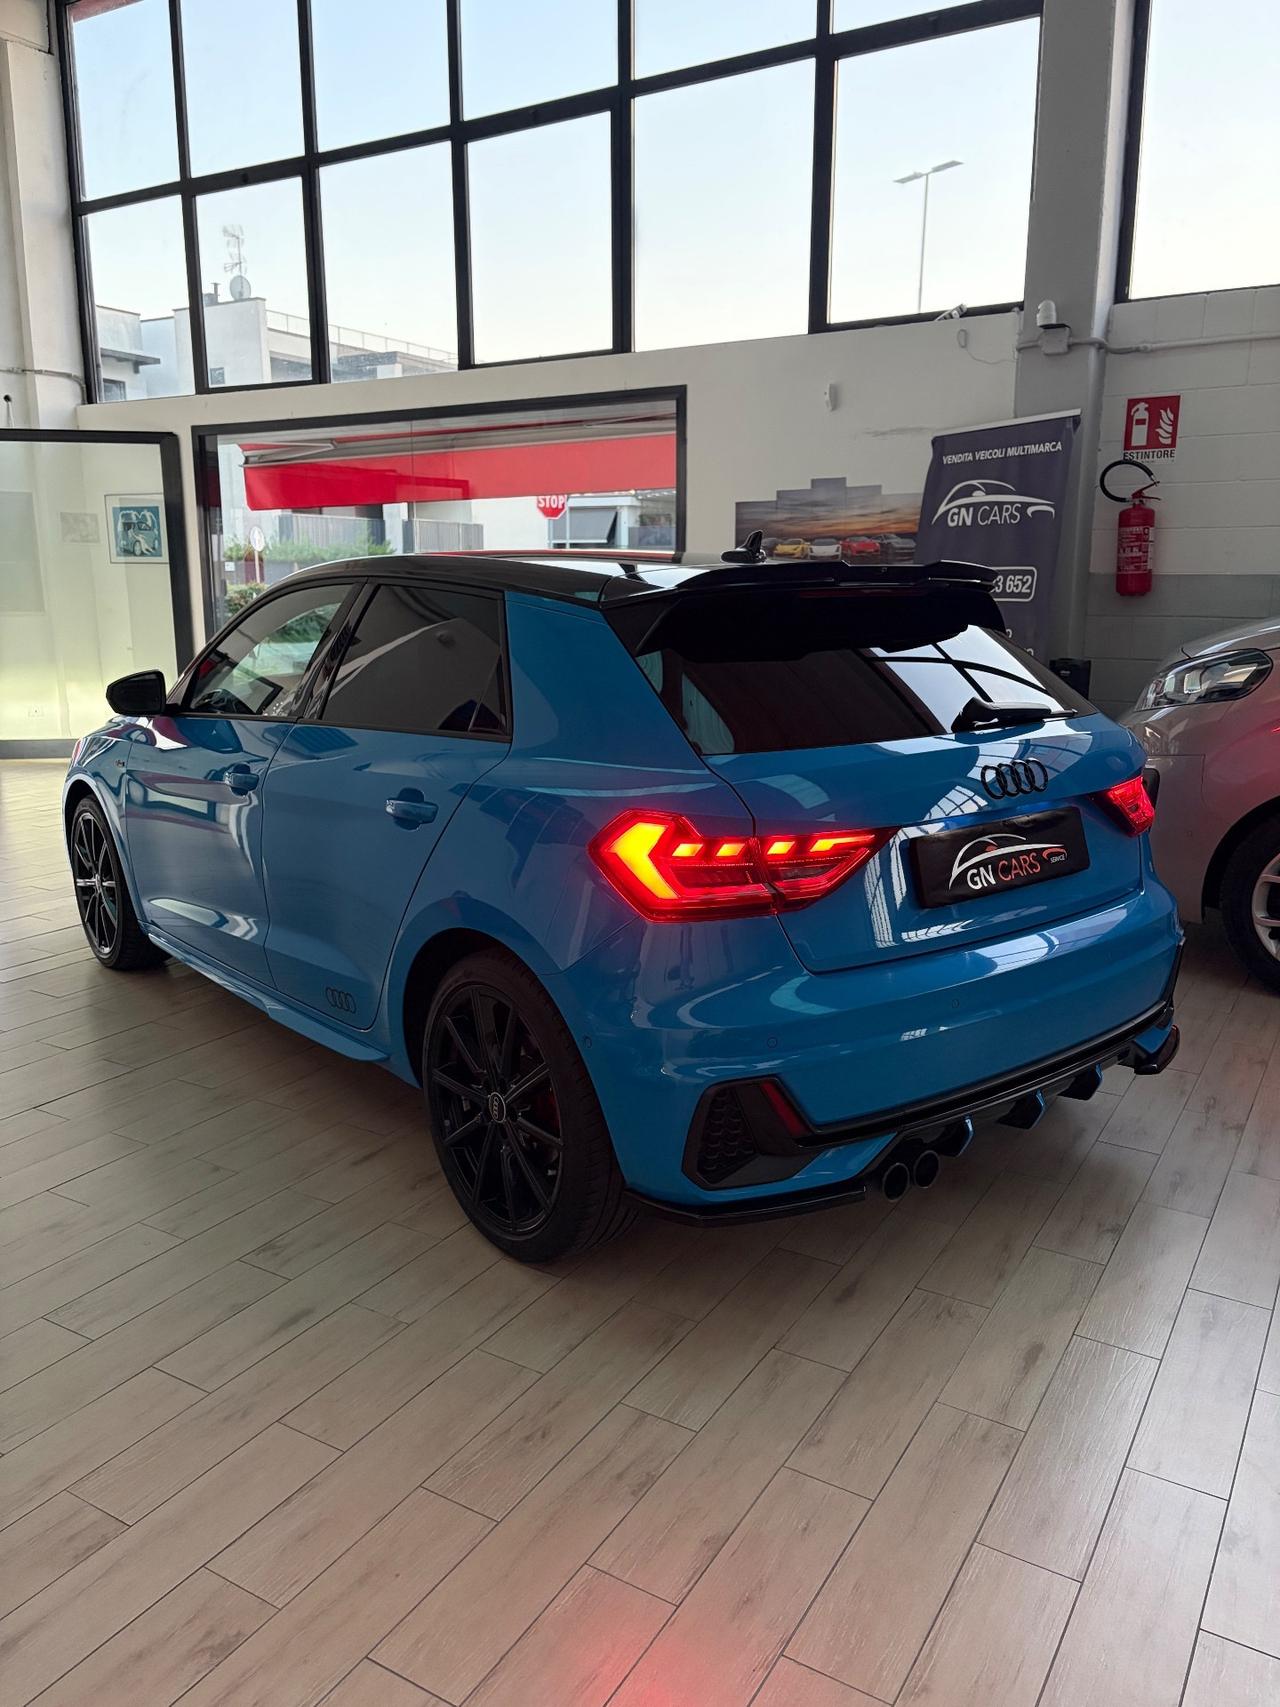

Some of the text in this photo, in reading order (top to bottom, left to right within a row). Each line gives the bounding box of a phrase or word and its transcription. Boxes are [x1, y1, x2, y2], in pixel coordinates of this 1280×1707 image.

[943, 441, 1062, 464] VENDITA VEICOLI MULTIMARCA
[1123, 449, 1176, 461] ESTINTORE
[538, 495, 565, 508] STOP
[947, 503, 1022, 527] GN CARS
[1005, 575, 1032, 593] 652
[966, 852, 1041, 890] GN CARS
